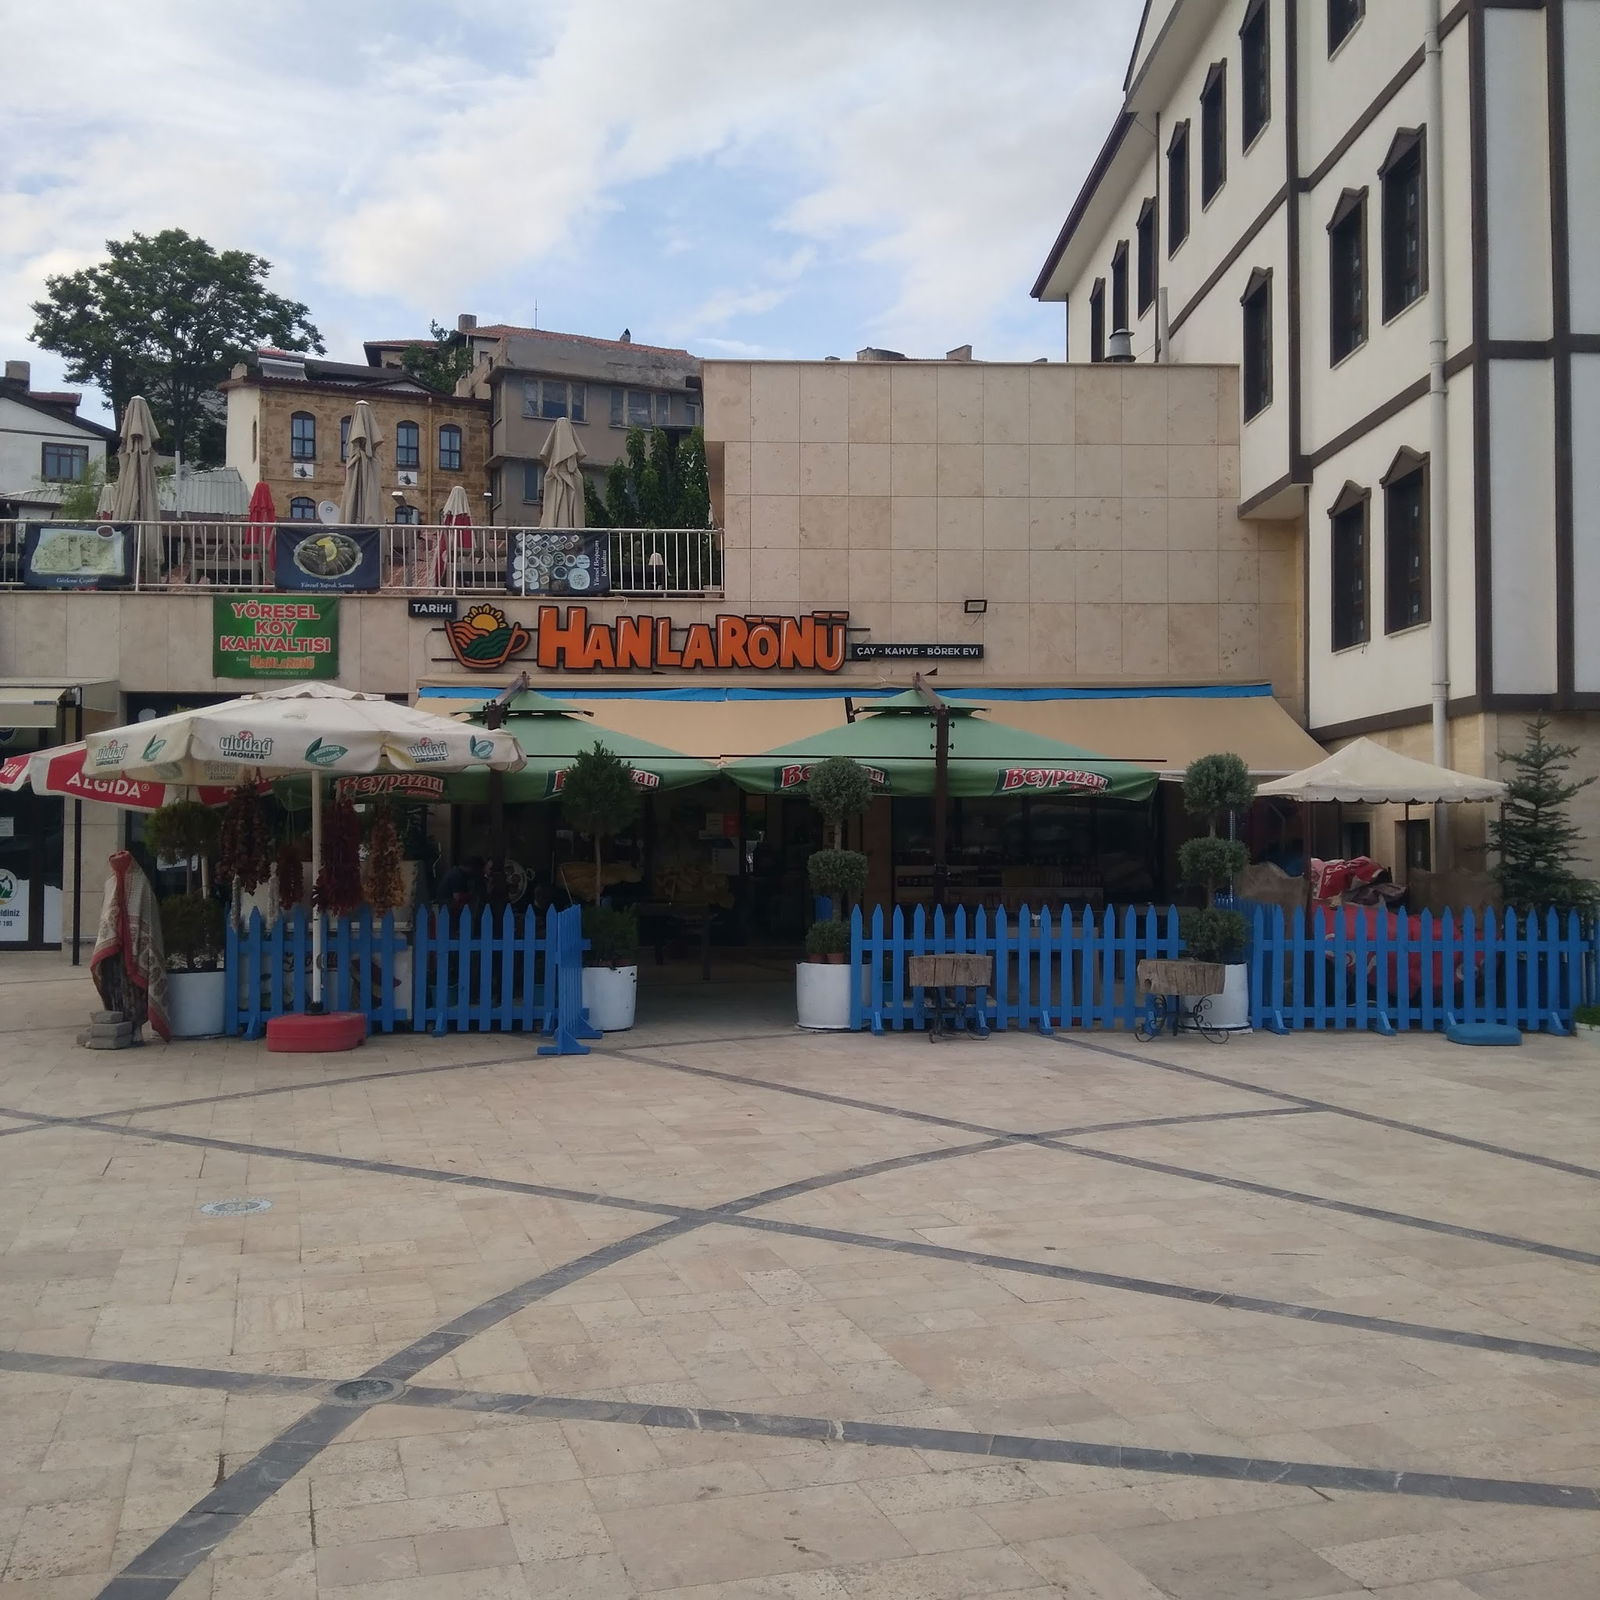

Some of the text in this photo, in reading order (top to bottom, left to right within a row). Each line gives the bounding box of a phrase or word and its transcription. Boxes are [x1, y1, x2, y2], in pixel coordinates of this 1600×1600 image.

[231, 600, 320, 619] YÖRESEL
[255, 618, 297, 635] KÖY
[220, 636, 331, 653] KAHVALTISI
[536, 605, 849, 672] HANLARÖNÜ
[856, 647, 877, 656] ÇAY
[884, 647, 919, 656] KAHVE
[926, 646, 961, 656] BÖREK
[219, 735, 274, 756] uludağ
[408, 741, 450, 758] uludağ
[1002, 767, 1109, 791] Beypazarı
